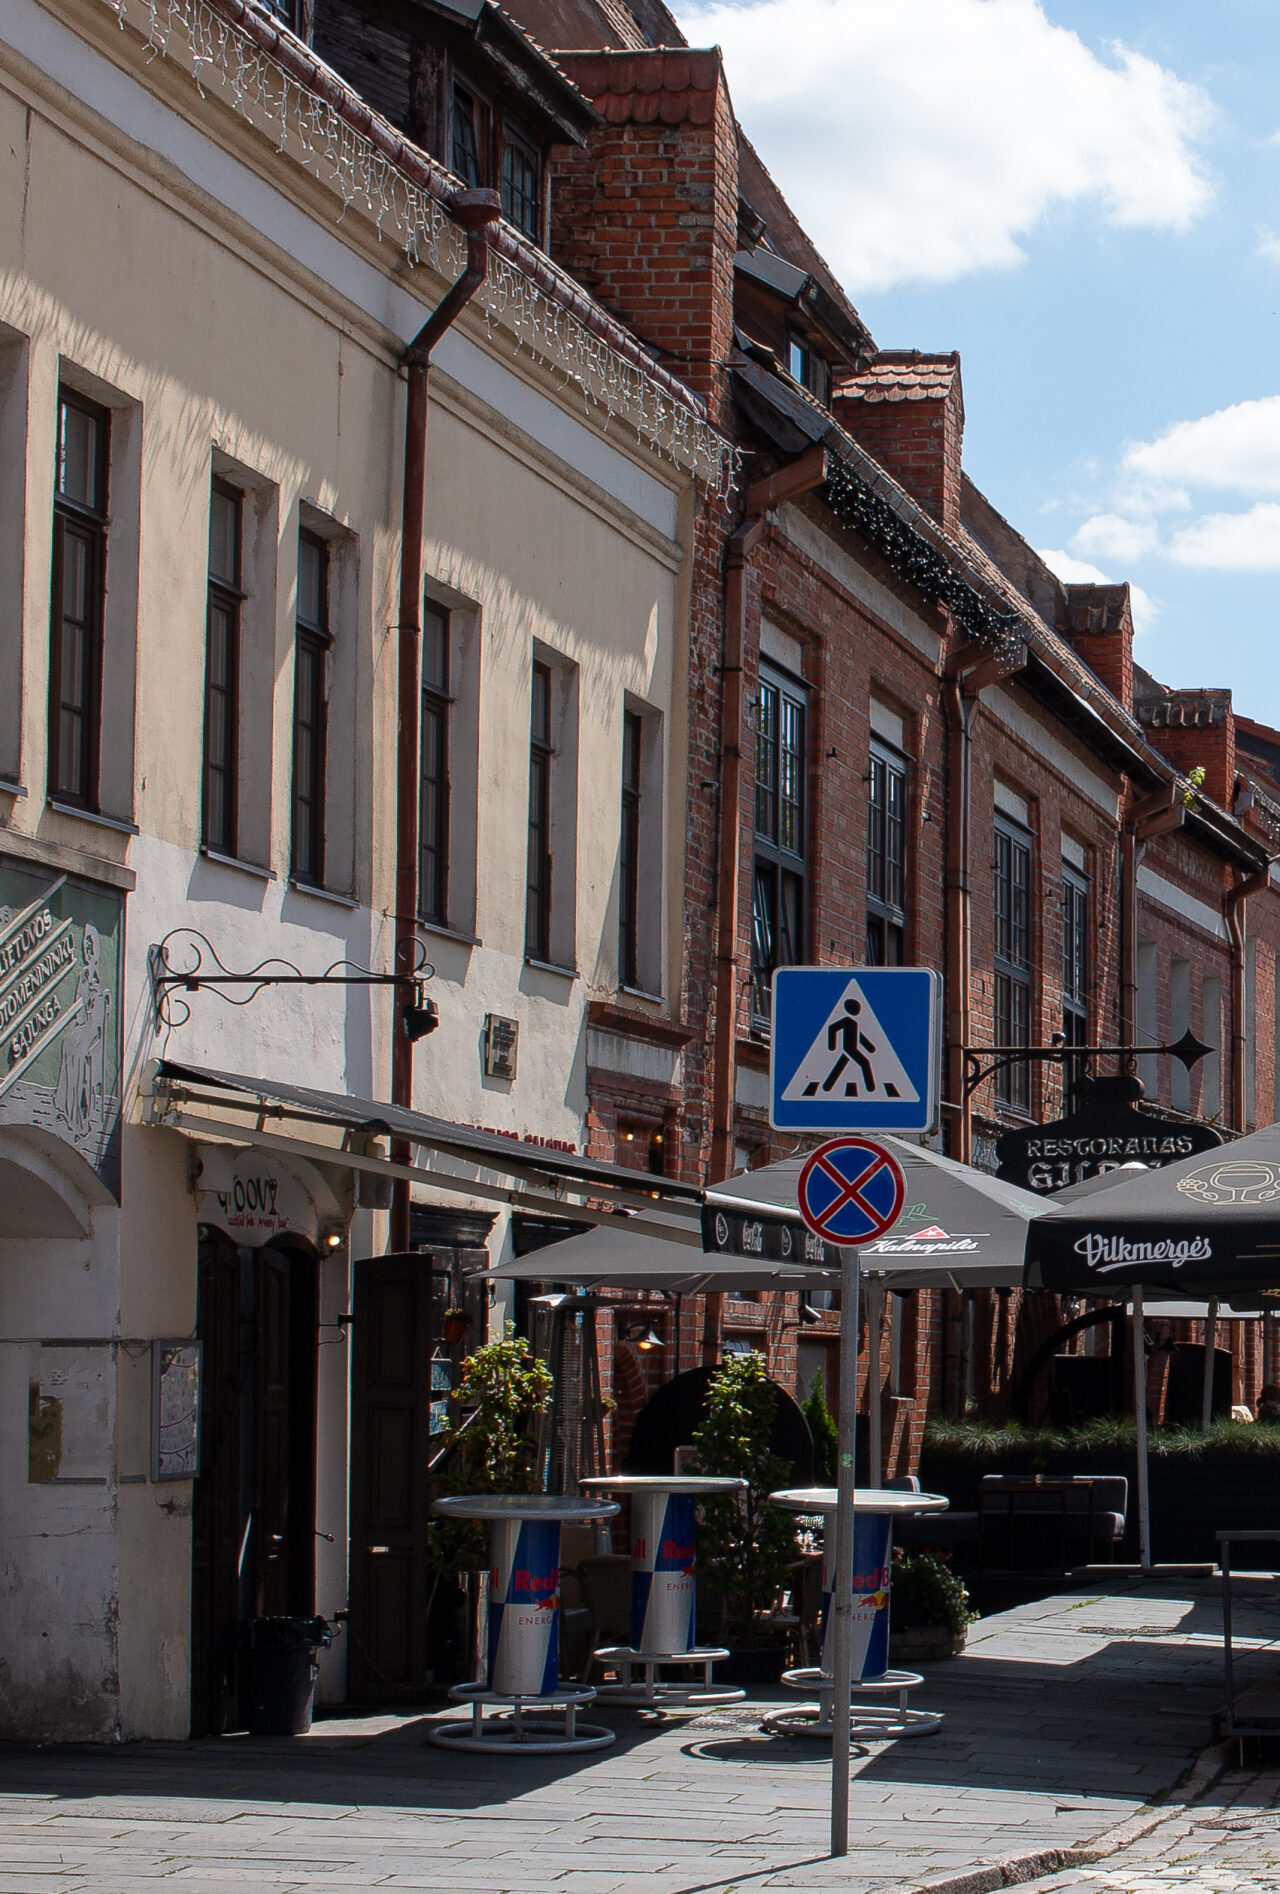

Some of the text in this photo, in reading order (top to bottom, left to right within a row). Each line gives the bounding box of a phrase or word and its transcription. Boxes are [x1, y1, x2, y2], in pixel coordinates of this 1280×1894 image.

[11, 994, 62, 1059] SĄJUNGA
[1025, 1135, 1193, 1157] RESTORANAS
[860, 1237, 980, 1254] Kalnapilis
[1073, 1233, 1212, 1273] Vilkmergės
[514, 1567, 555, 1592] Red
[852, 1566, 880, 1590] ed
